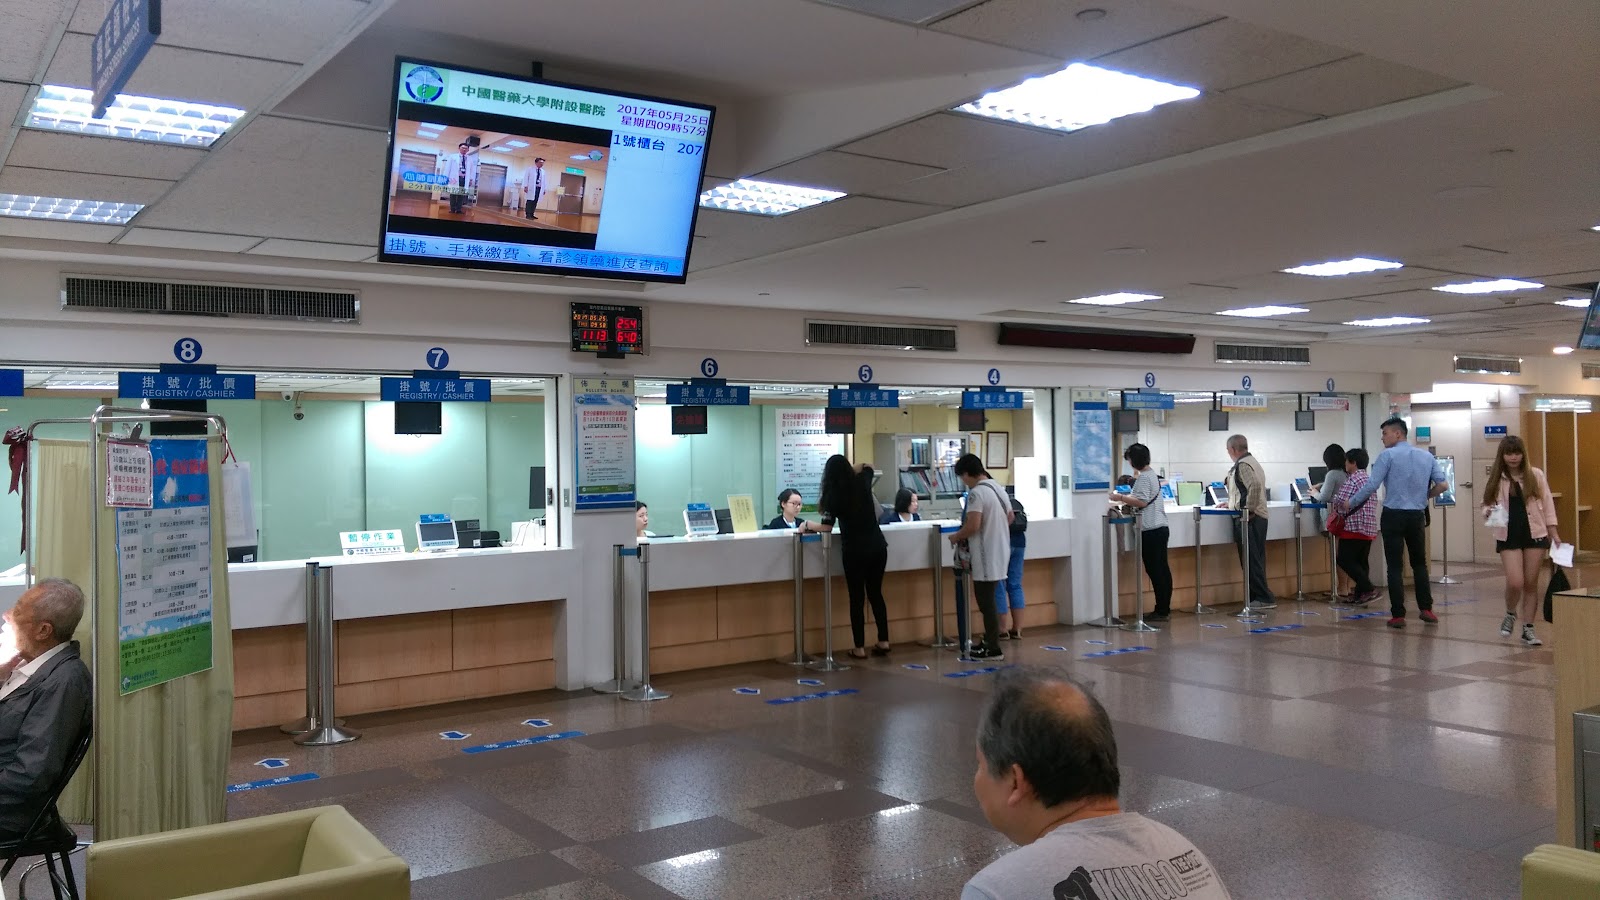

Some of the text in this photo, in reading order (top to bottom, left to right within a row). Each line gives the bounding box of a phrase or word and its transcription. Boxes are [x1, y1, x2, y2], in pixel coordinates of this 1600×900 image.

[462, 84, 606, 117] 中國醫藥大學附設醫院
[617, 103, 709, 126] 2017年05月25日
[621, 115, 708, 137] 星期四09時57分
[613, 134, 703, 156] 1號櫃台 207
[582, 330, 607, 342] 1113
[180, 340, 196, 361] 8
[431, 349, 444, 368] 7
[704, 359, 715, 376] 6
[861, 366, 870, 381] 5
[989, 369, 999, 384] 4
